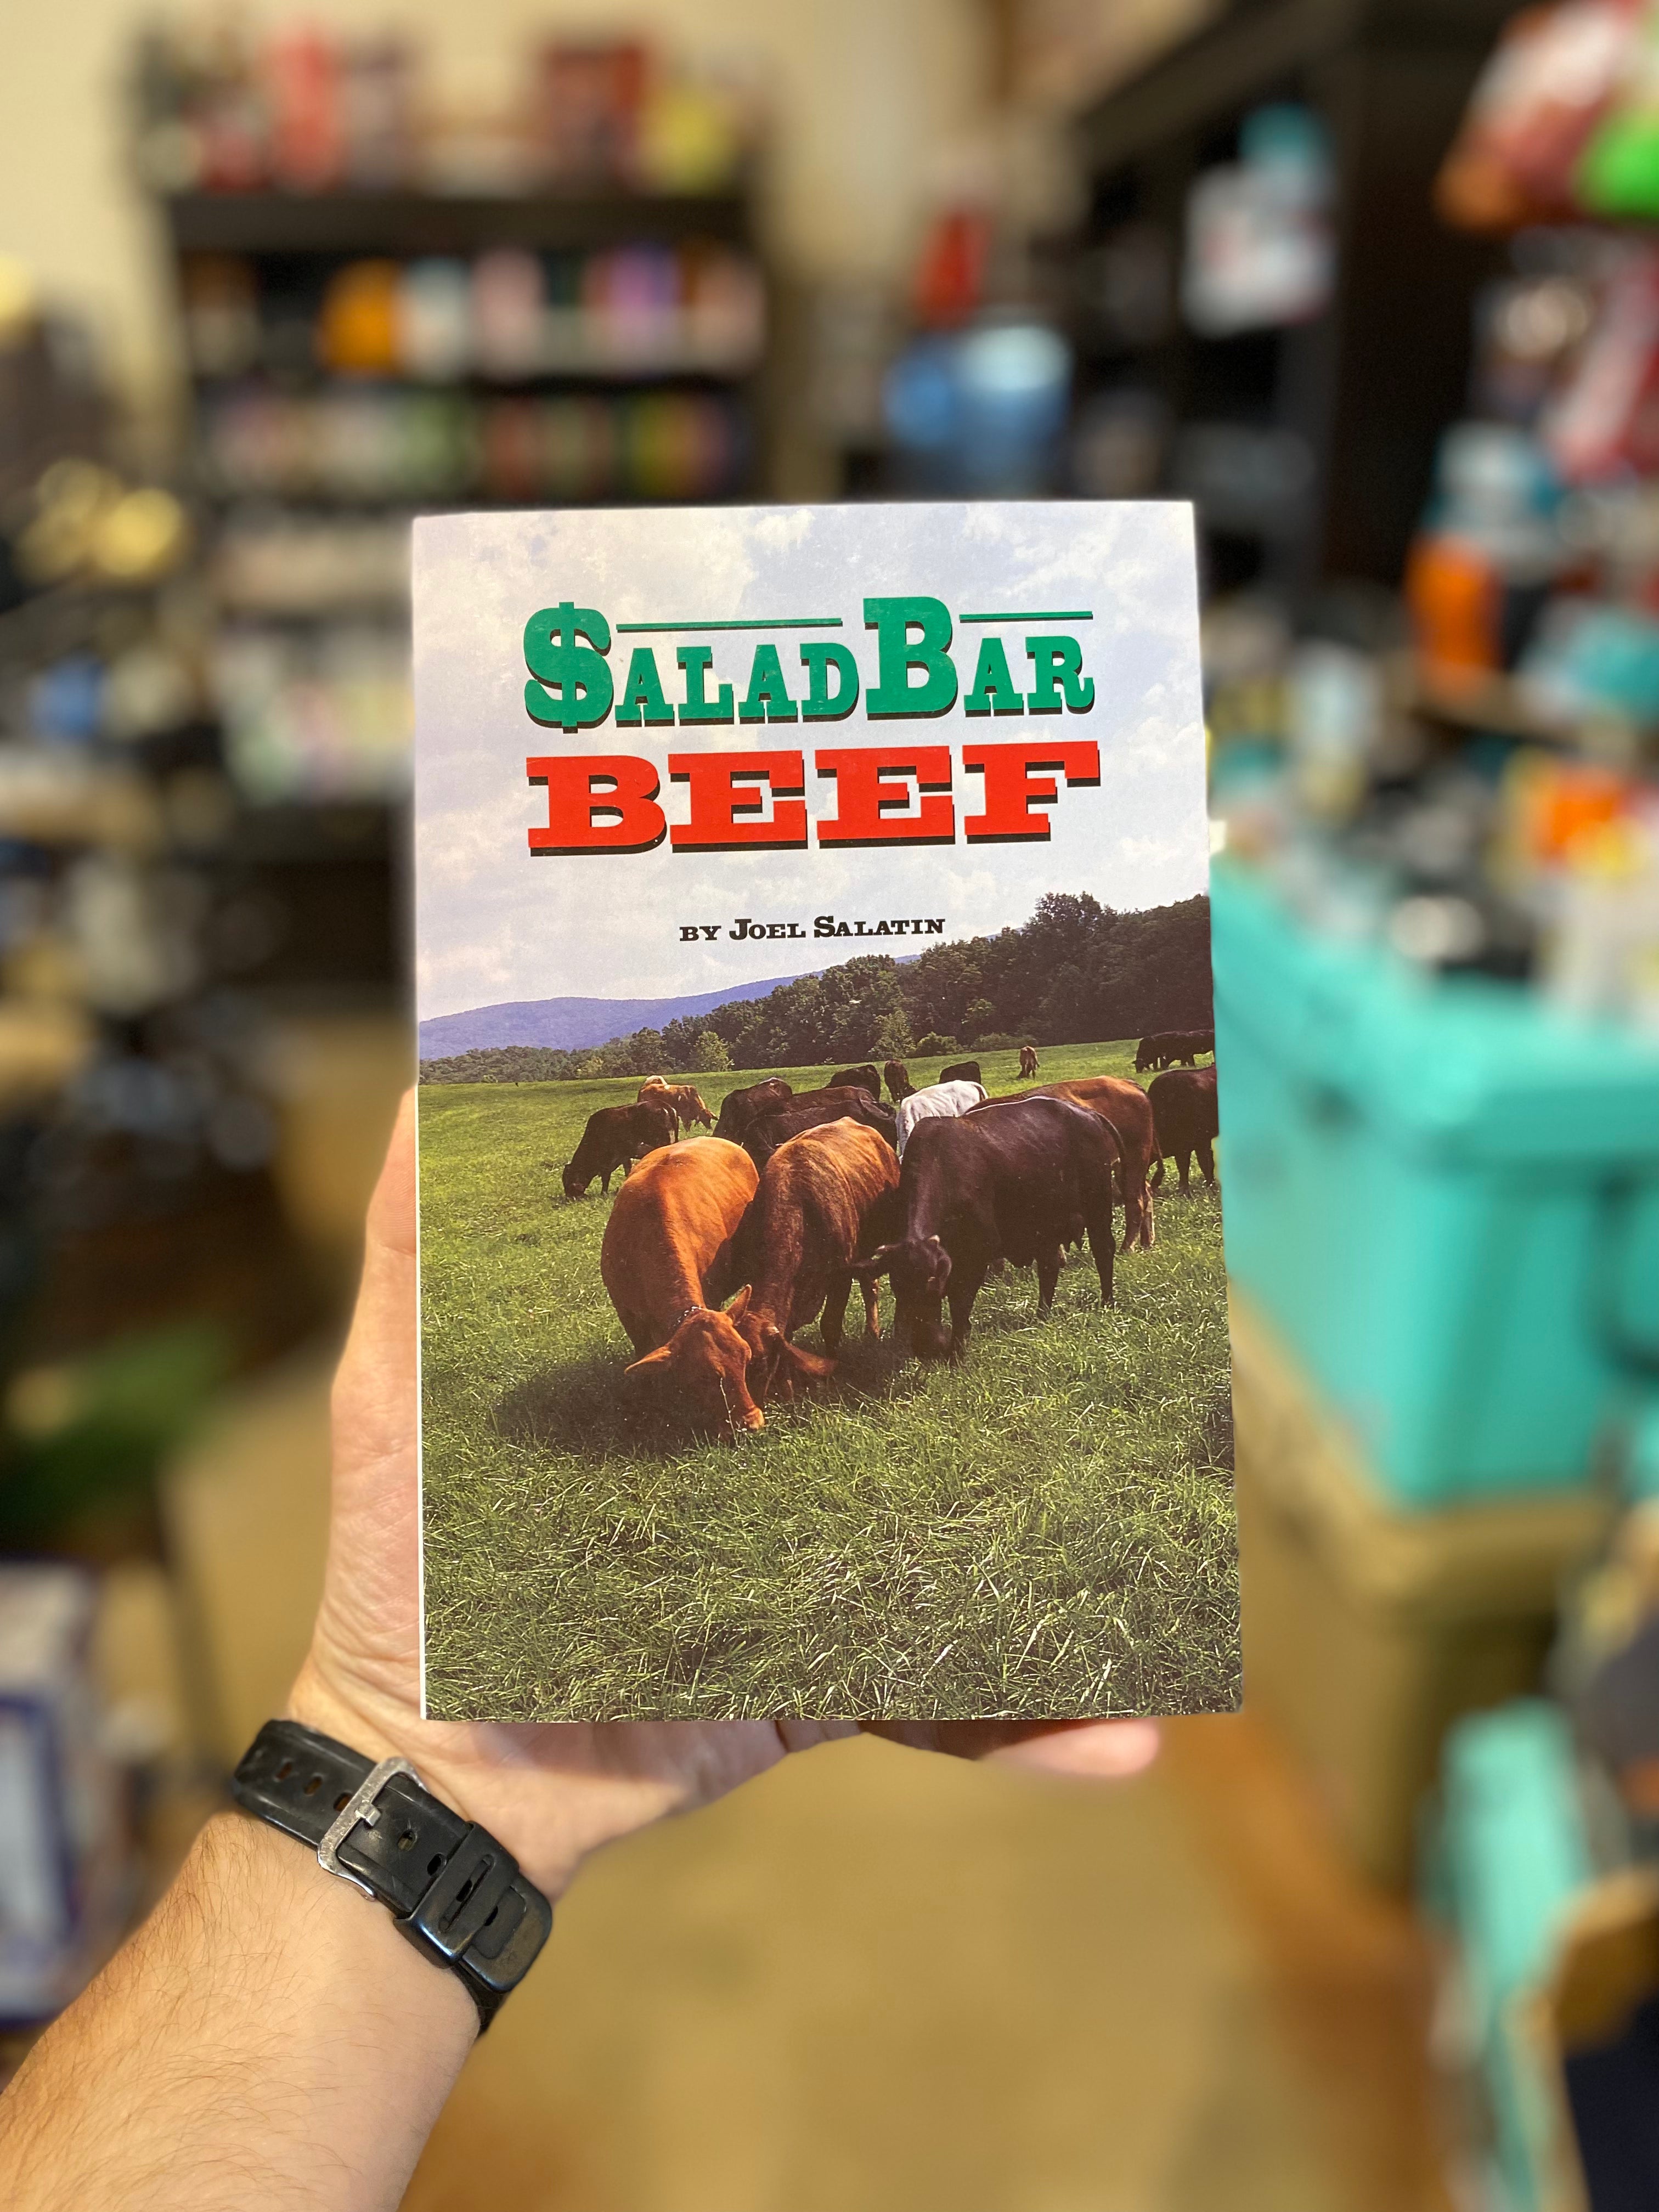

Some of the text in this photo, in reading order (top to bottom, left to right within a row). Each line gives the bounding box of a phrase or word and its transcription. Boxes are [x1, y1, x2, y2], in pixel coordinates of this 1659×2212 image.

[864, 596, 1095, 721] BAR
[526, 741, 1101, 857] BEEF
[680, 916, 945, 941] BY JOEL SALATIN
